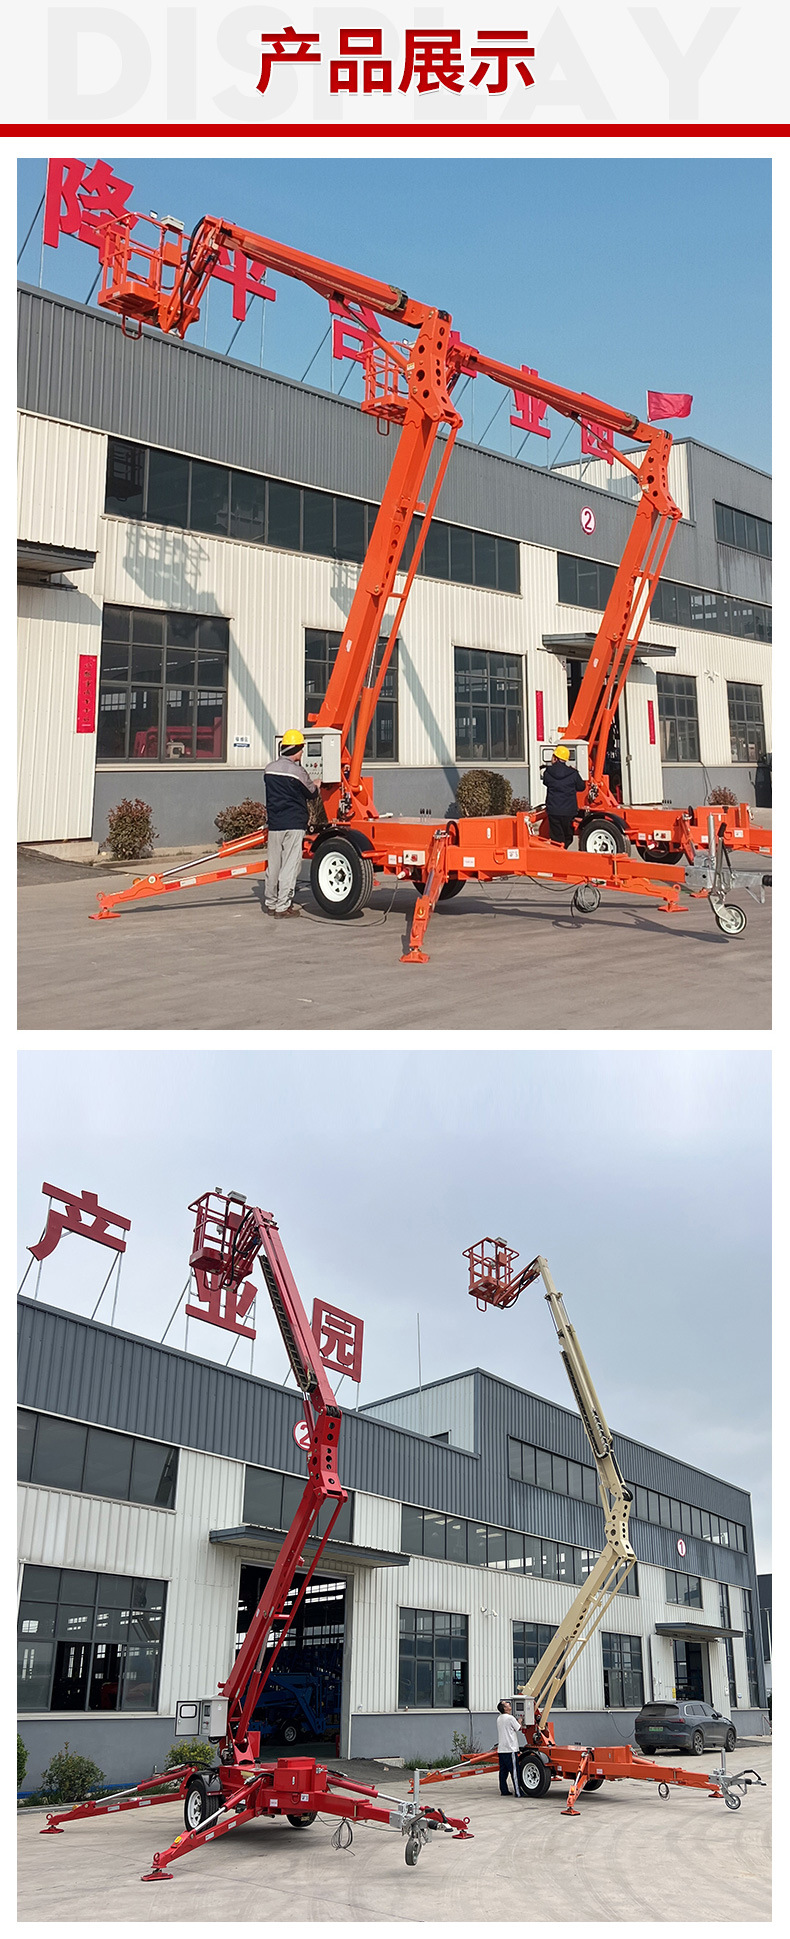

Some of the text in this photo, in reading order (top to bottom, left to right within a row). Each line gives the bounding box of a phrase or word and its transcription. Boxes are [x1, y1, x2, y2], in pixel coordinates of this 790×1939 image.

[583, 509, 593, 532] 2
[27, 1181, 365, 1383] 产业园
